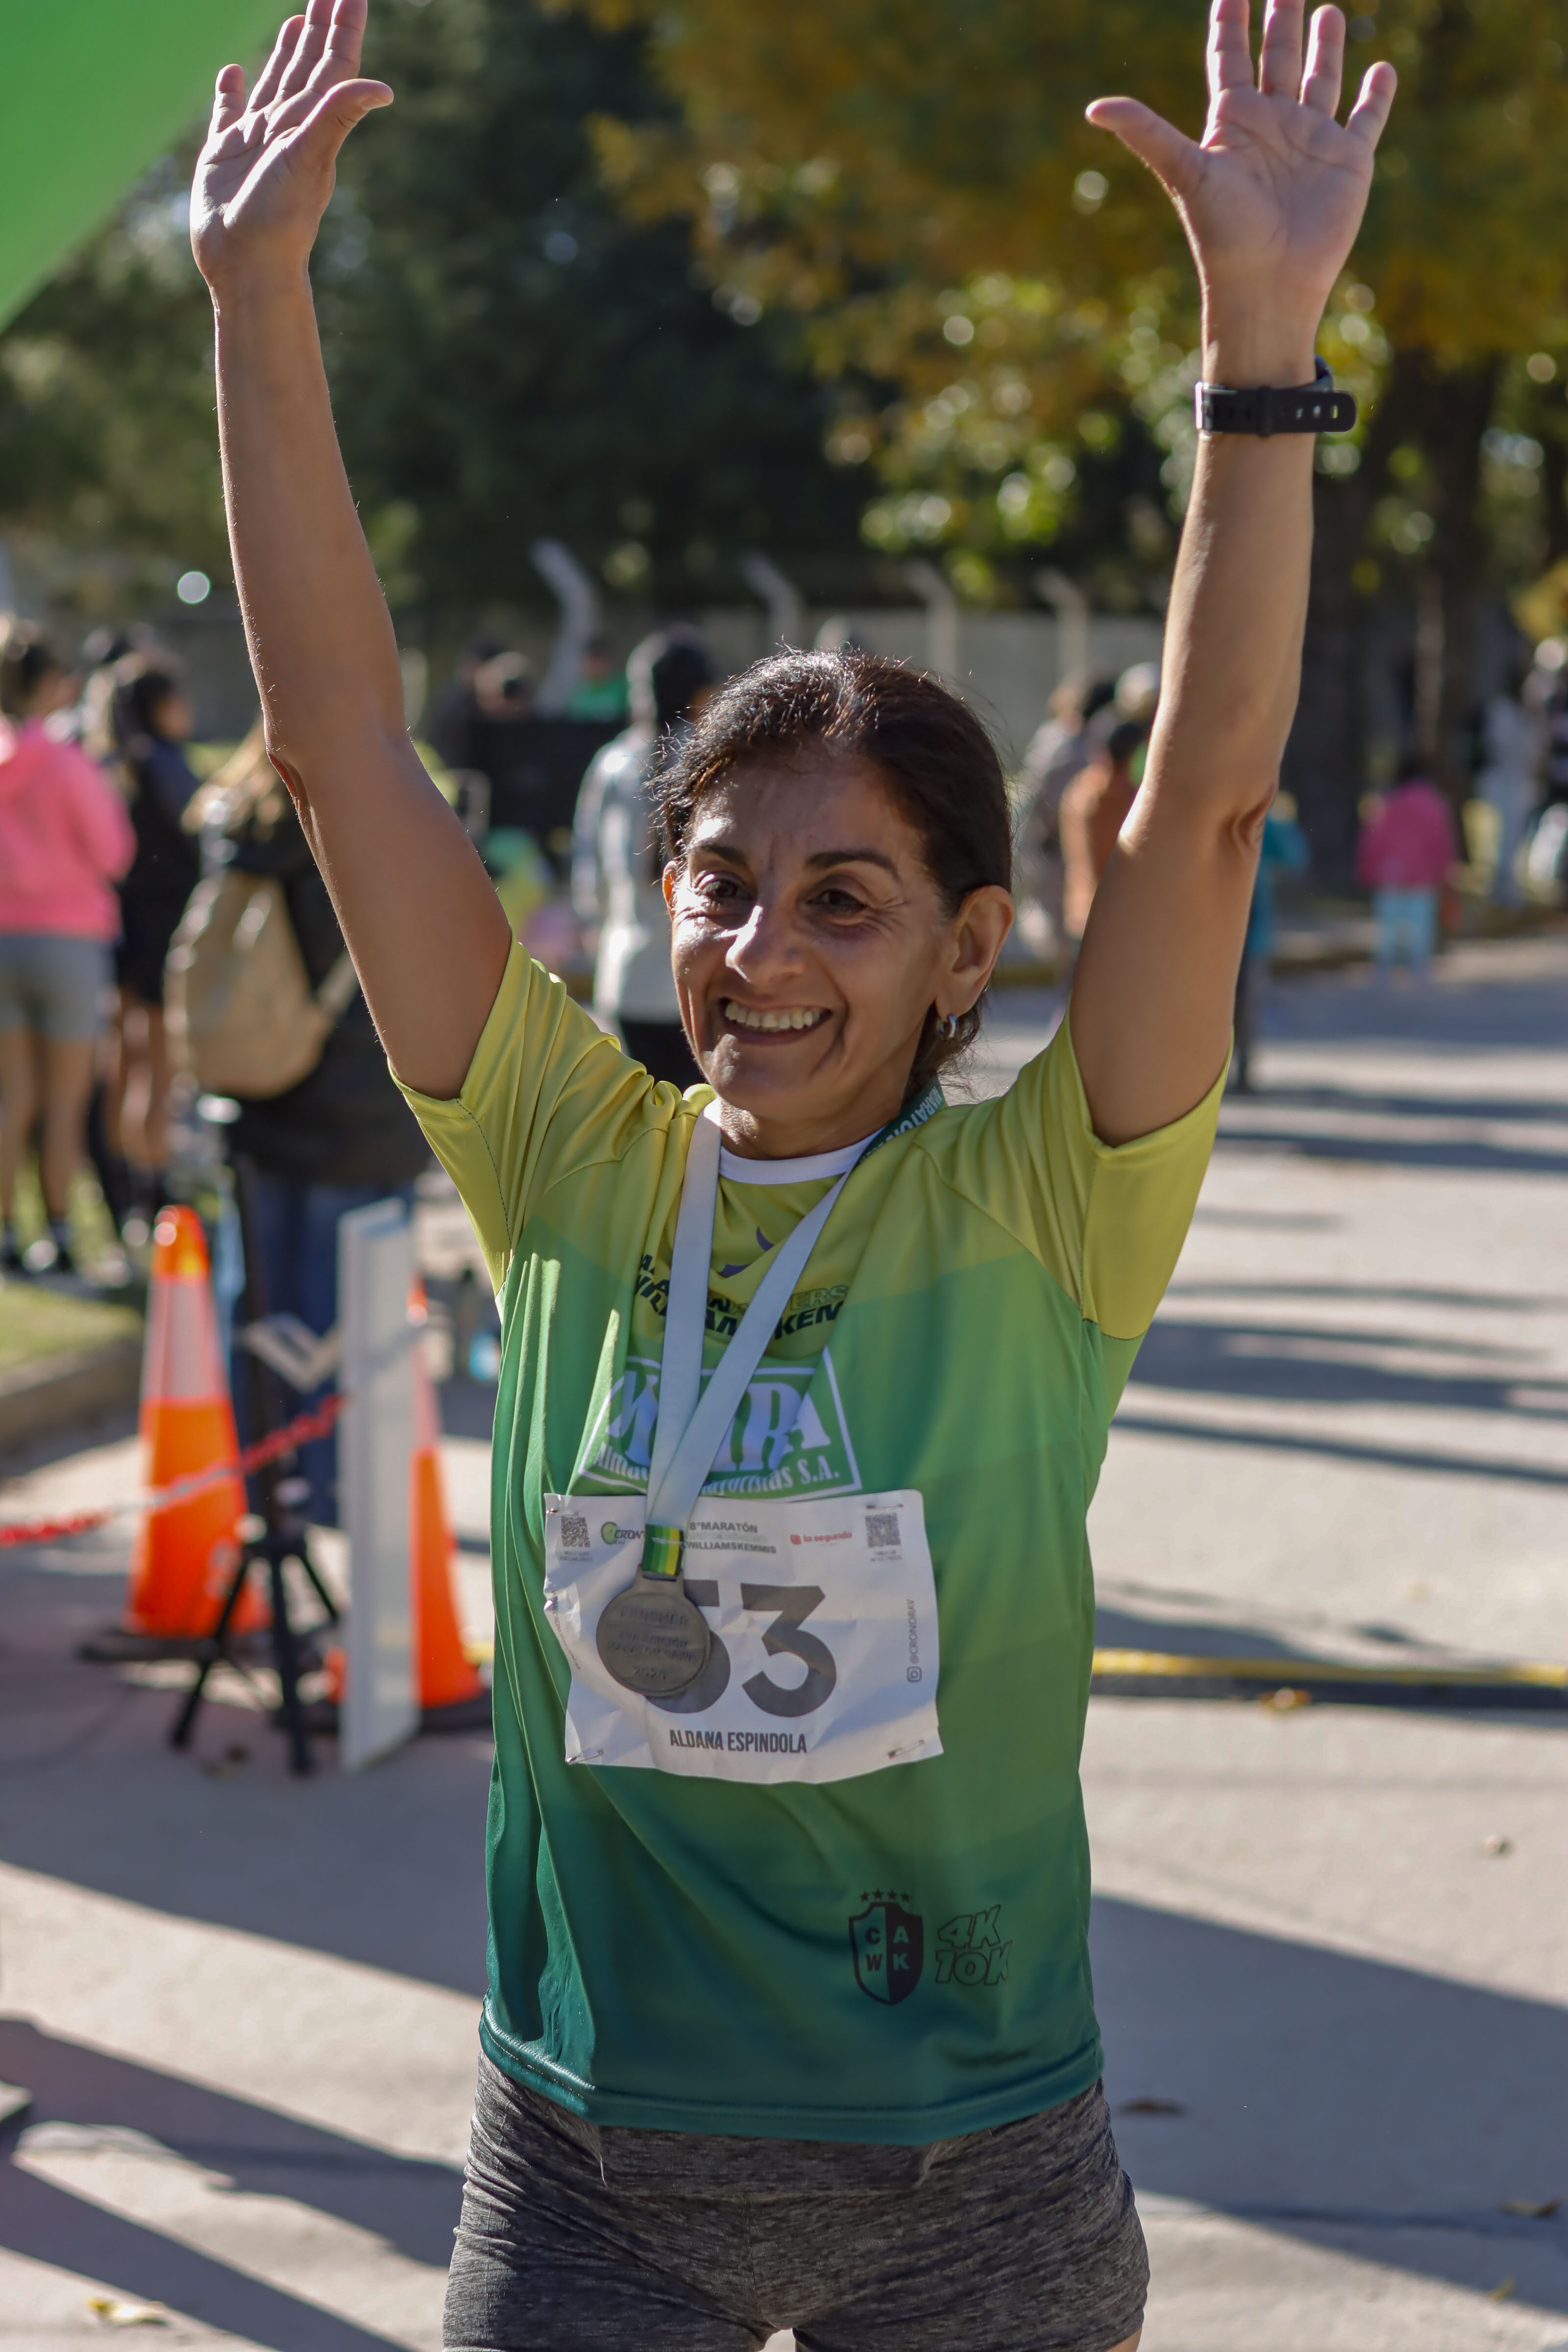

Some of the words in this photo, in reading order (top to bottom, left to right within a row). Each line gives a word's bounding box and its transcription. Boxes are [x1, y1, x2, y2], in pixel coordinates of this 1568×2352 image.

[669, 1729, 724, 1751] ALDANA
[727, 1732, 808, 1753] ESPINDOLA
[937, 1904, 1001, 1949] 4K
